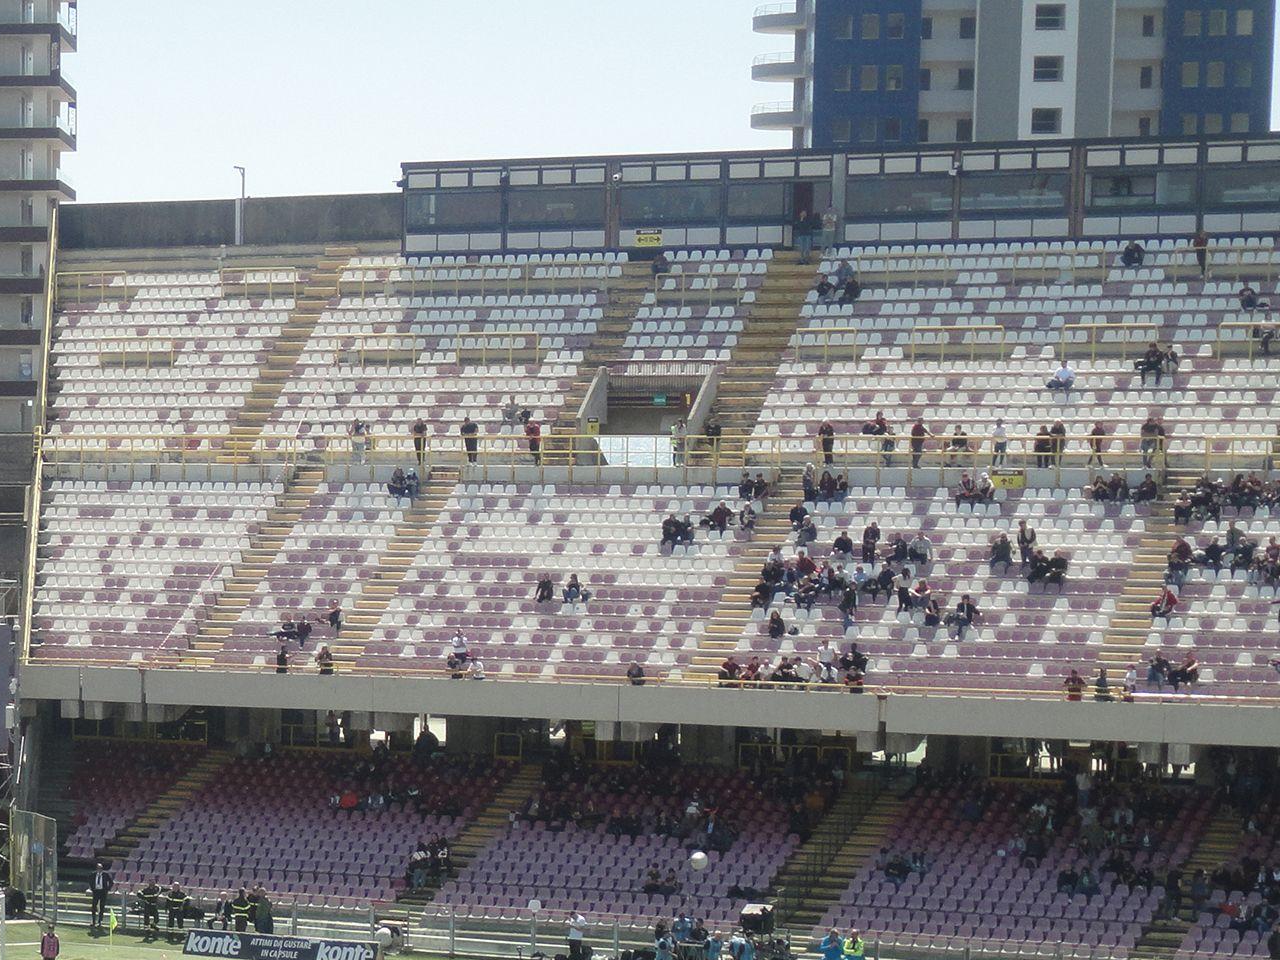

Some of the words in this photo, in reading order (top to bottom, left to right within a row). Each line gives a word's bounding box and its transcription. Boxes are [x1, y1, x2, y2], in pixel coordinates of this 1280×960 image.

[250, 937, 274, 948] ATTIMI
[283, 940, 312, 950] GUSTARE
[260, 949, 269, 957] IN
[269, 950, 299, 959] CAPSULE
